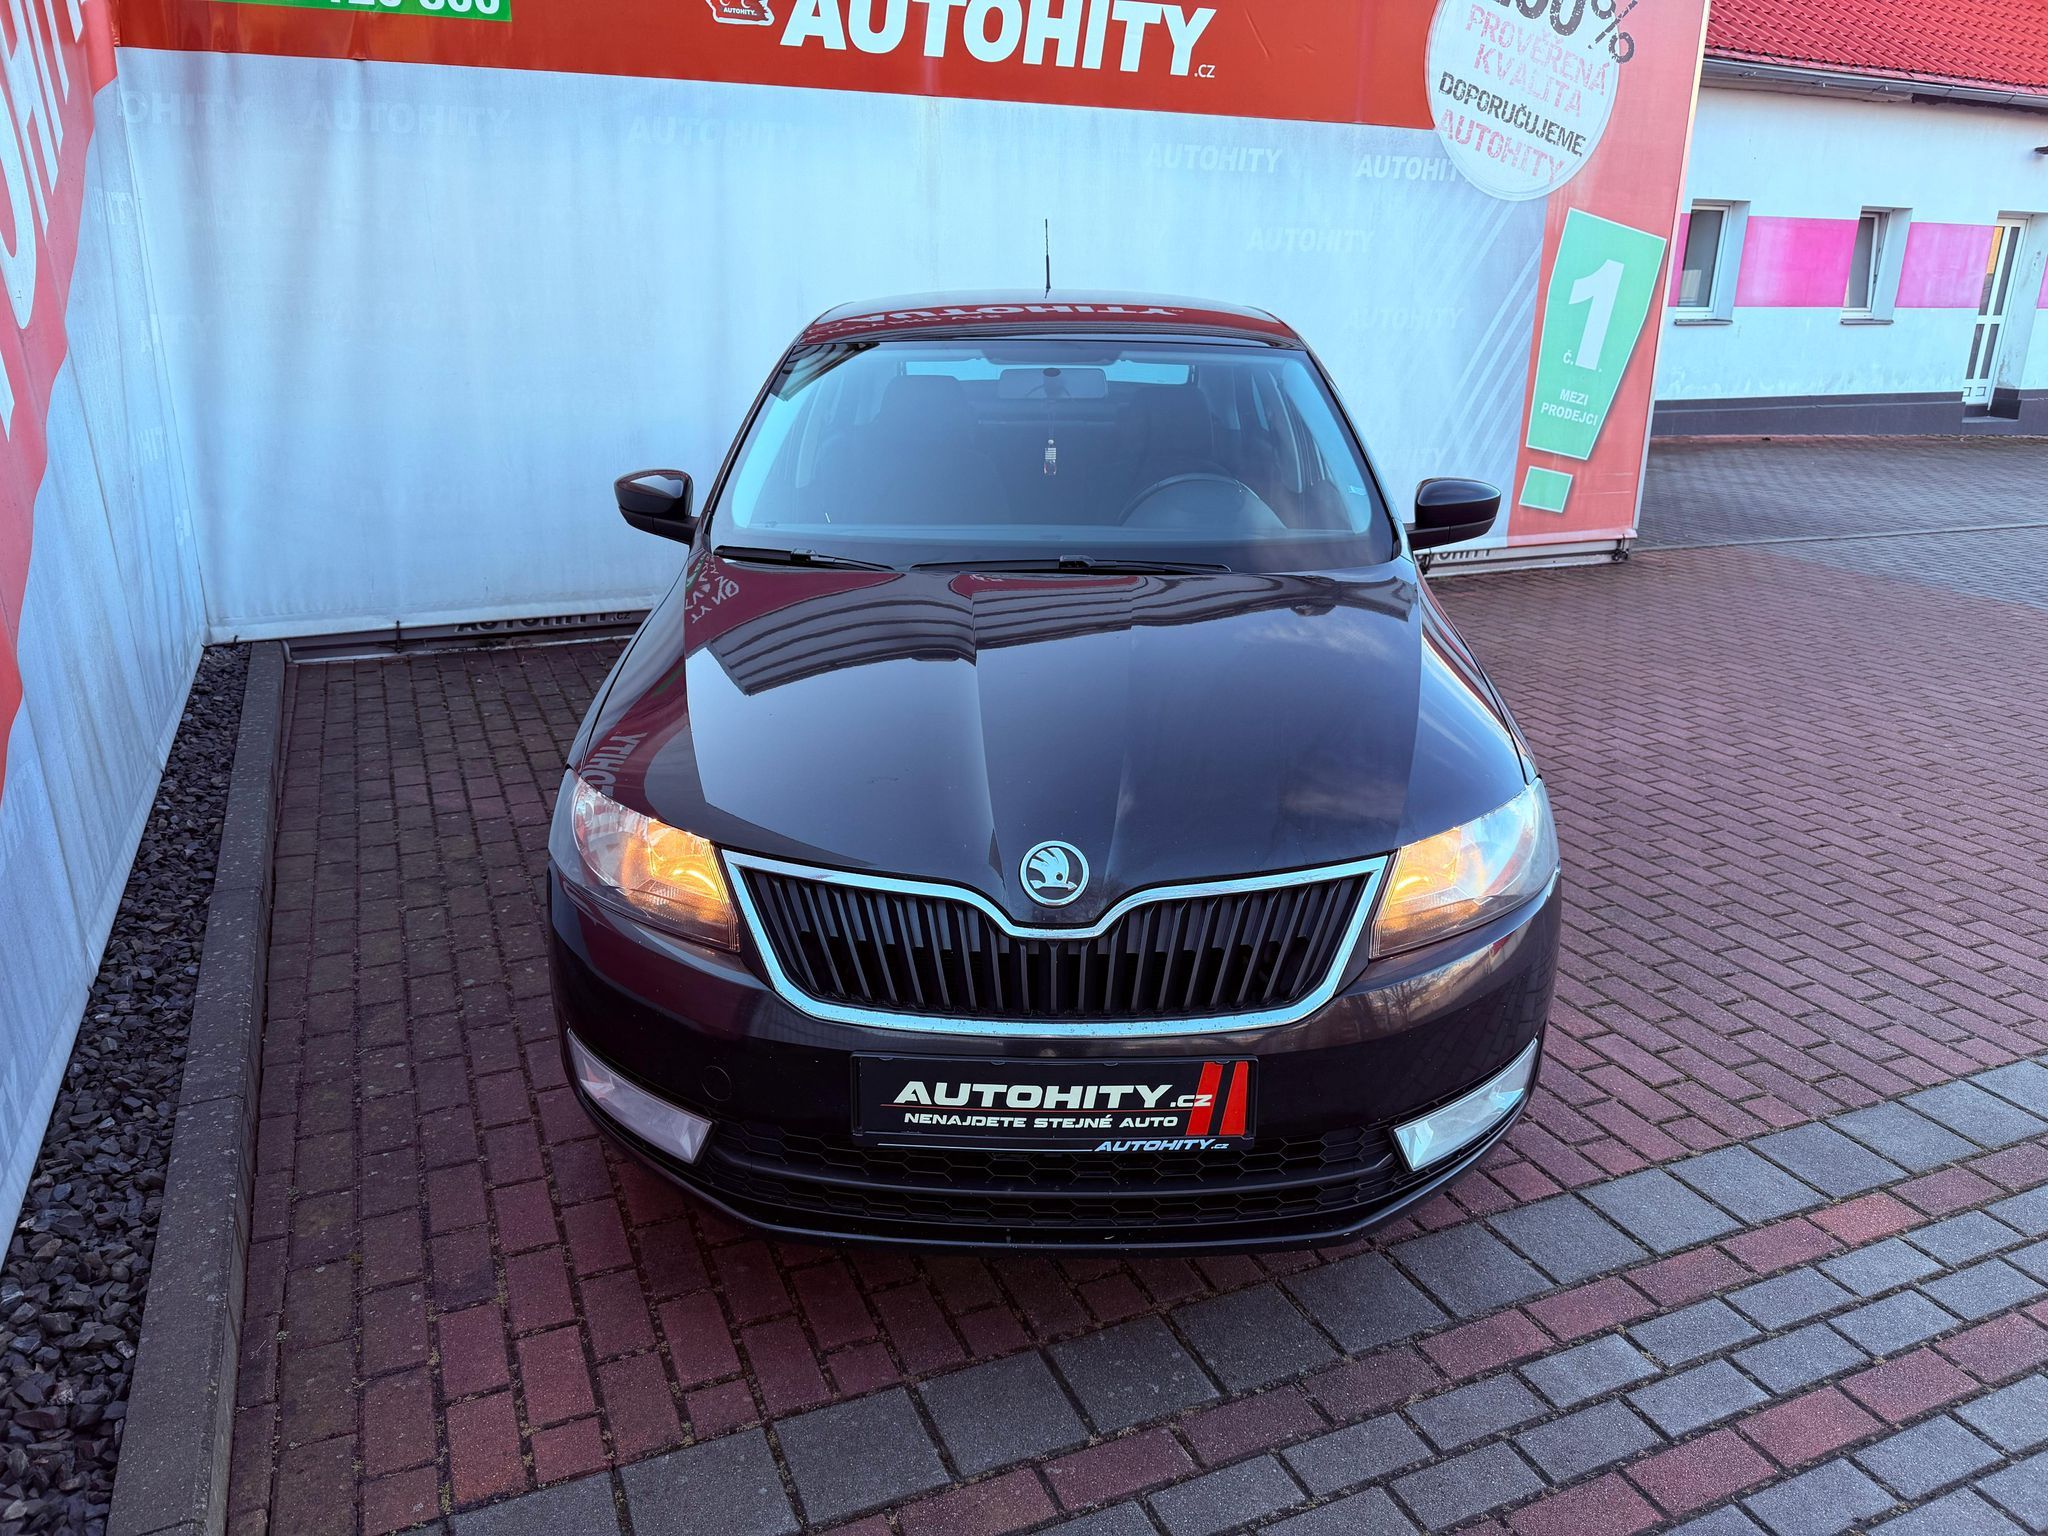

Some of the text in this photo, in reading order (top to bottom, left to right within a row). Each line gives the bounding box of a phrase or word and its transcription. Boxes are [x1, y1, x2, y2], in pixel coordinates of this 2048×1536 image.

[1474, 43, 1583, 117] KVALITA
[1439, 71, 1587, 157] DOPORUČUJEME
[1146, 144, 1282, 173] AUTOHITY
[1437, 108, 1566, 183] AUTOHITY
[1355, 156, 1470, 184] AUTOHIT
[1246, 227, 1376, 253] AUTOHITY
[1560, 388, 1589, 406] MEZI
[1540, 402, 1599, 426] PRODEJCI
[904, 1112, 1179, 1129] NENAJDETE STEJNÉ AUTO
